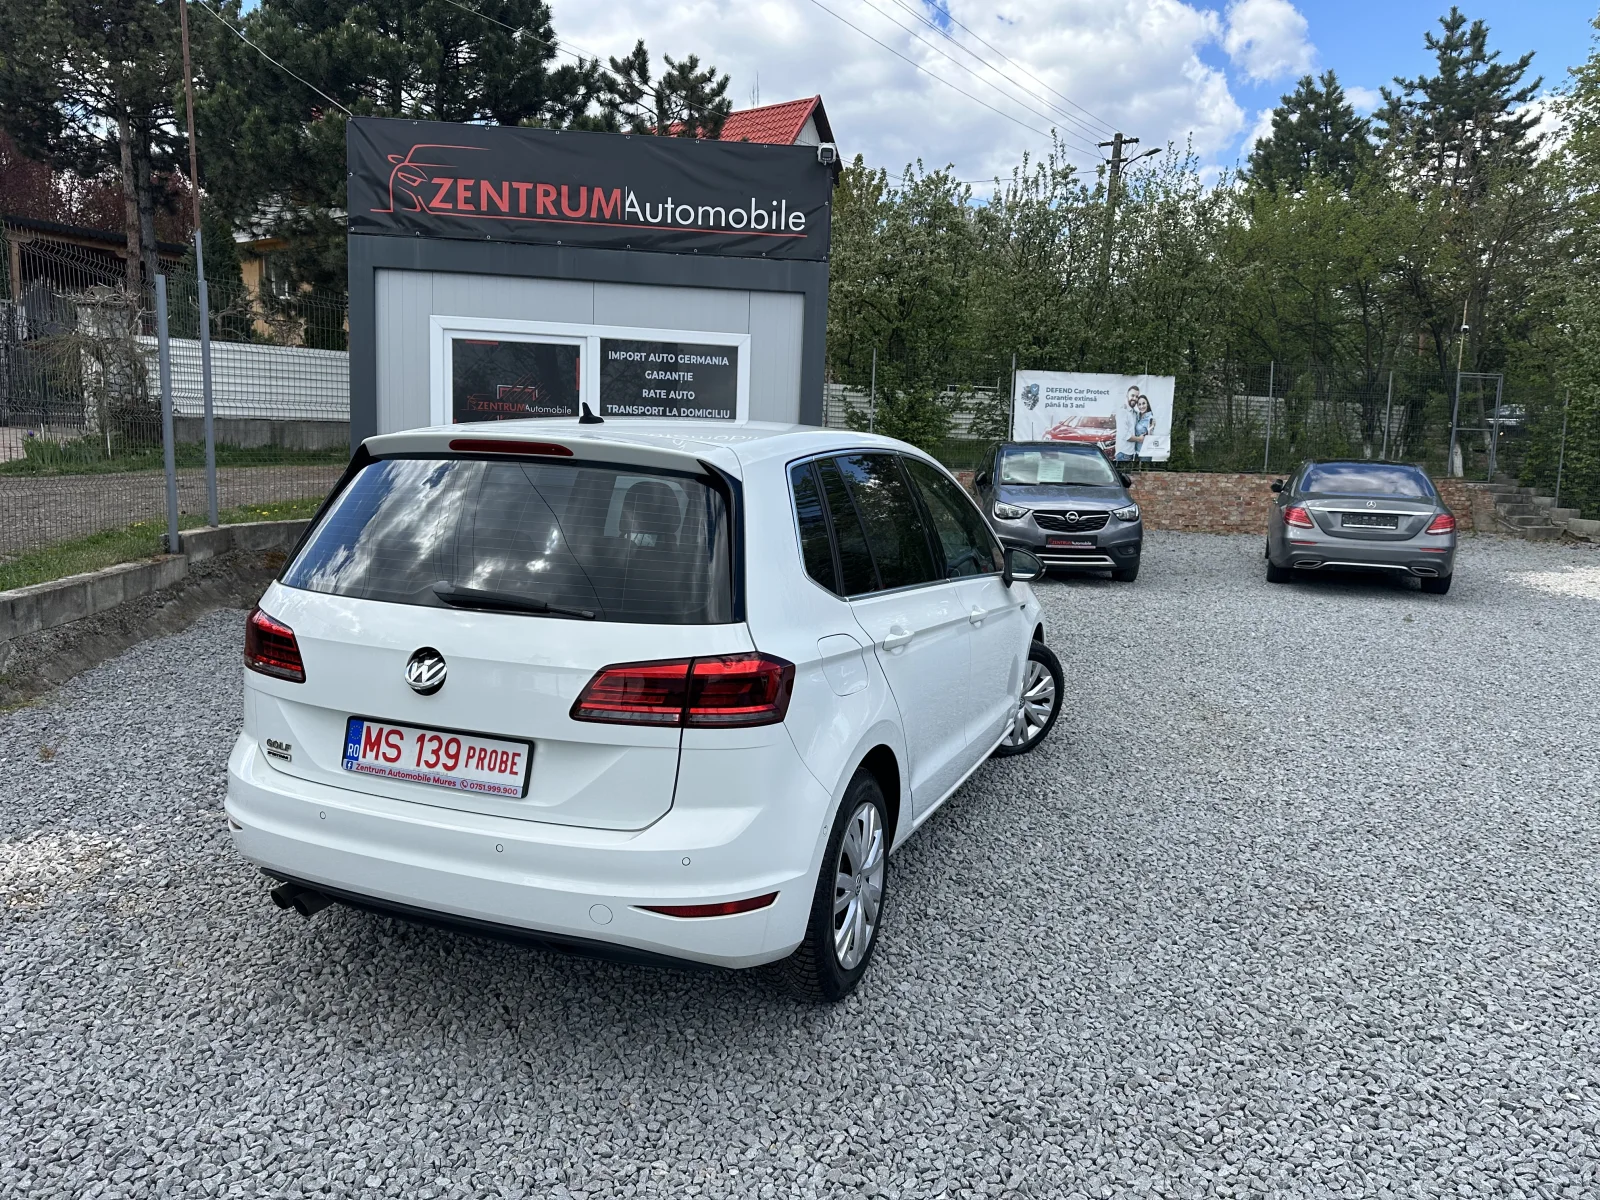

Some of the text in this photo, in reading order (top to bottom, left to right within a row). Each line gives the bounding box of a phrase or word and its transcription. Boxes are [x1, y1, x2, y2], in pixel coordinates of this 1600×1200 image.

[429, 177, 806, 231] ZENTRUM Automobile
[608, 351, 729, 365] IMPORT AUTO GERMANIA
[645, 370, 693, 383] GARANȚIE
[642, 389, 695, 400] RATE AUTO
[478, 401, 572, 415] ZENTRUM Automobile
[607, 404, 730, 418] TRANSPORT LA DOMICILIU
[347, 743, 360, 757] RO
[362, 725, 521, 776] MS 139 PROBE
[355, 763, 386, 776] Zentrum
[387, 769, 431, 782] Automobile
[432, 775, 457, 787] Mures
[469, 782, 518, 795] 0751.999.900
